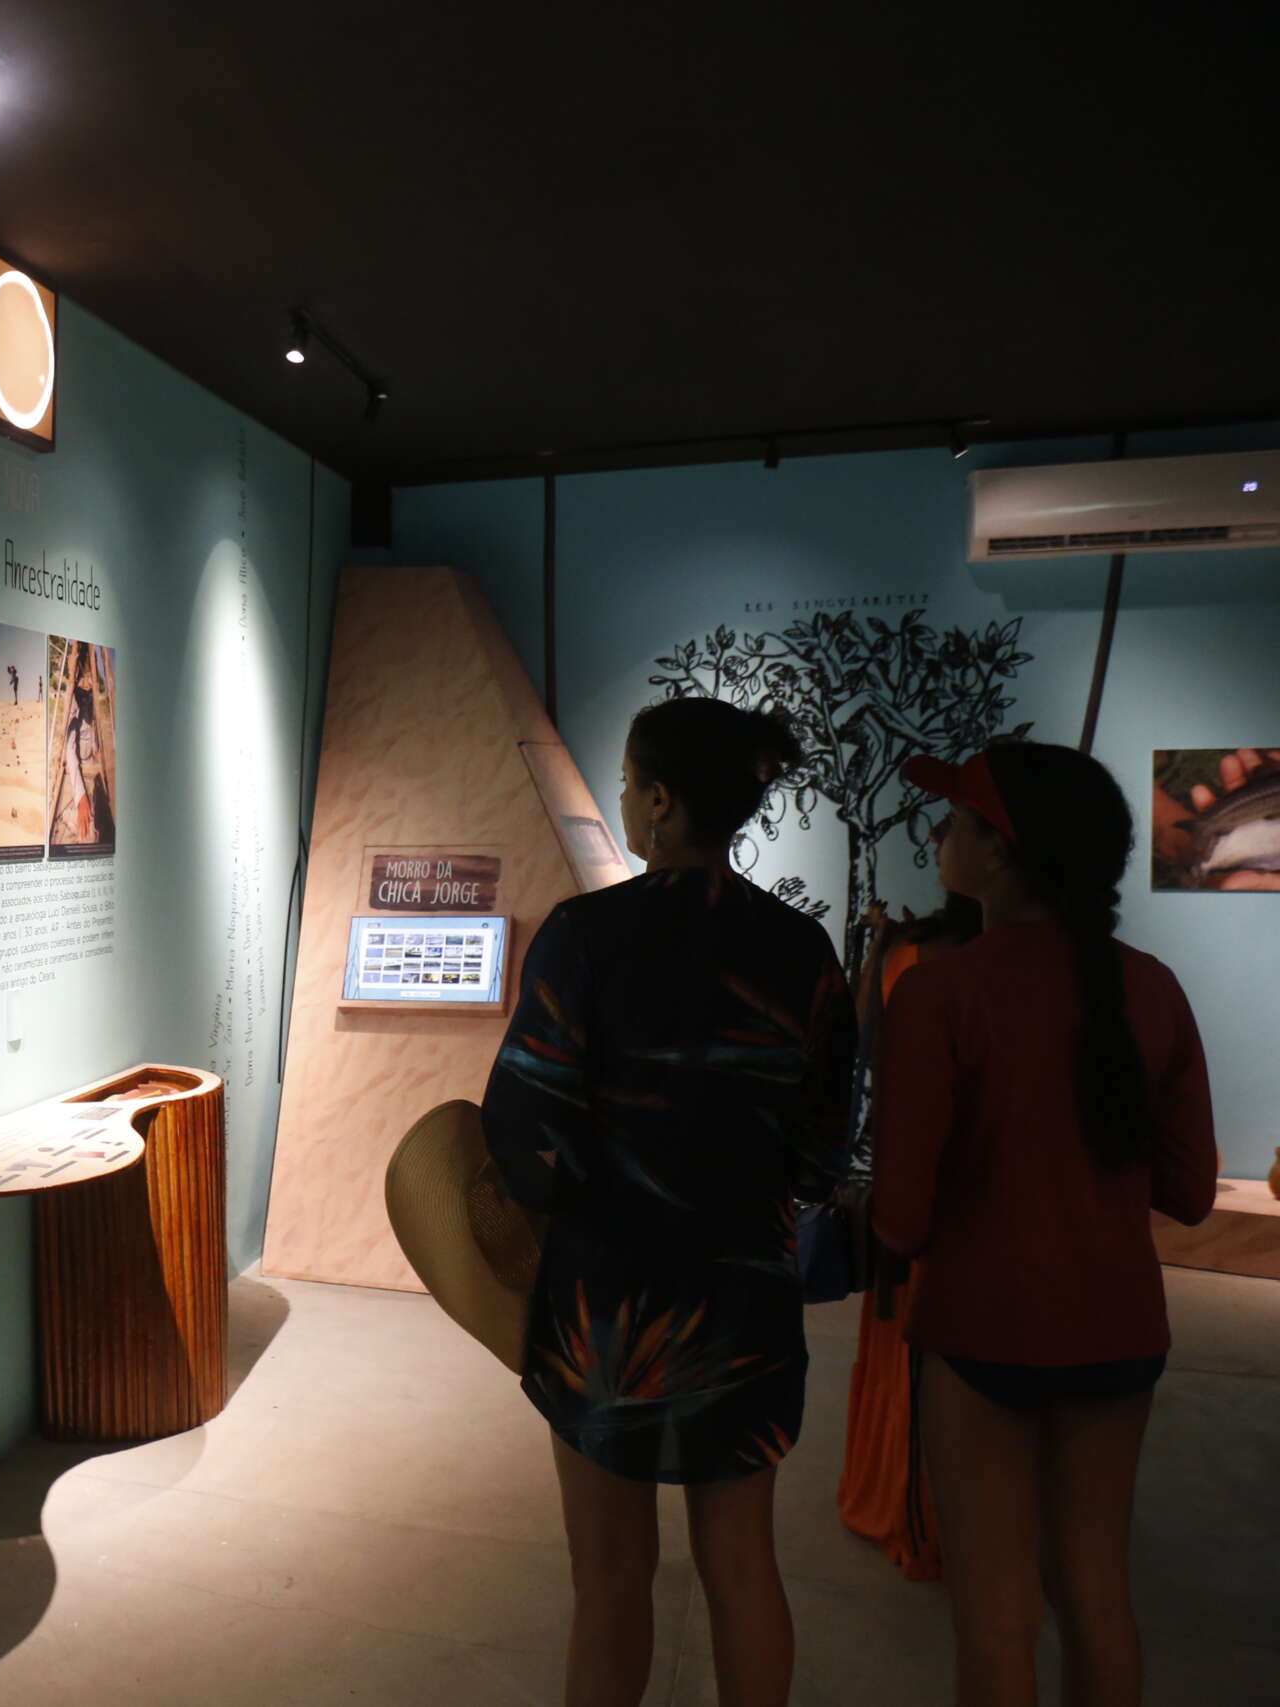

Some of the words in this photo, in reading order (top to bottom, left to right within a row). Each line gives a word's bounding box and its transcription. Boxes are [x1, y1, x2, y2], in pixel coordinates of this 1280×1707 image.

[4, 538, 102, 612] Ancestralidade
[385, 860, 431, 879] MORRO
[436, 860, 453, 880] DA
[378, 880, 421, 904] CHICA
[430, 881, 481, 905] JORGE
